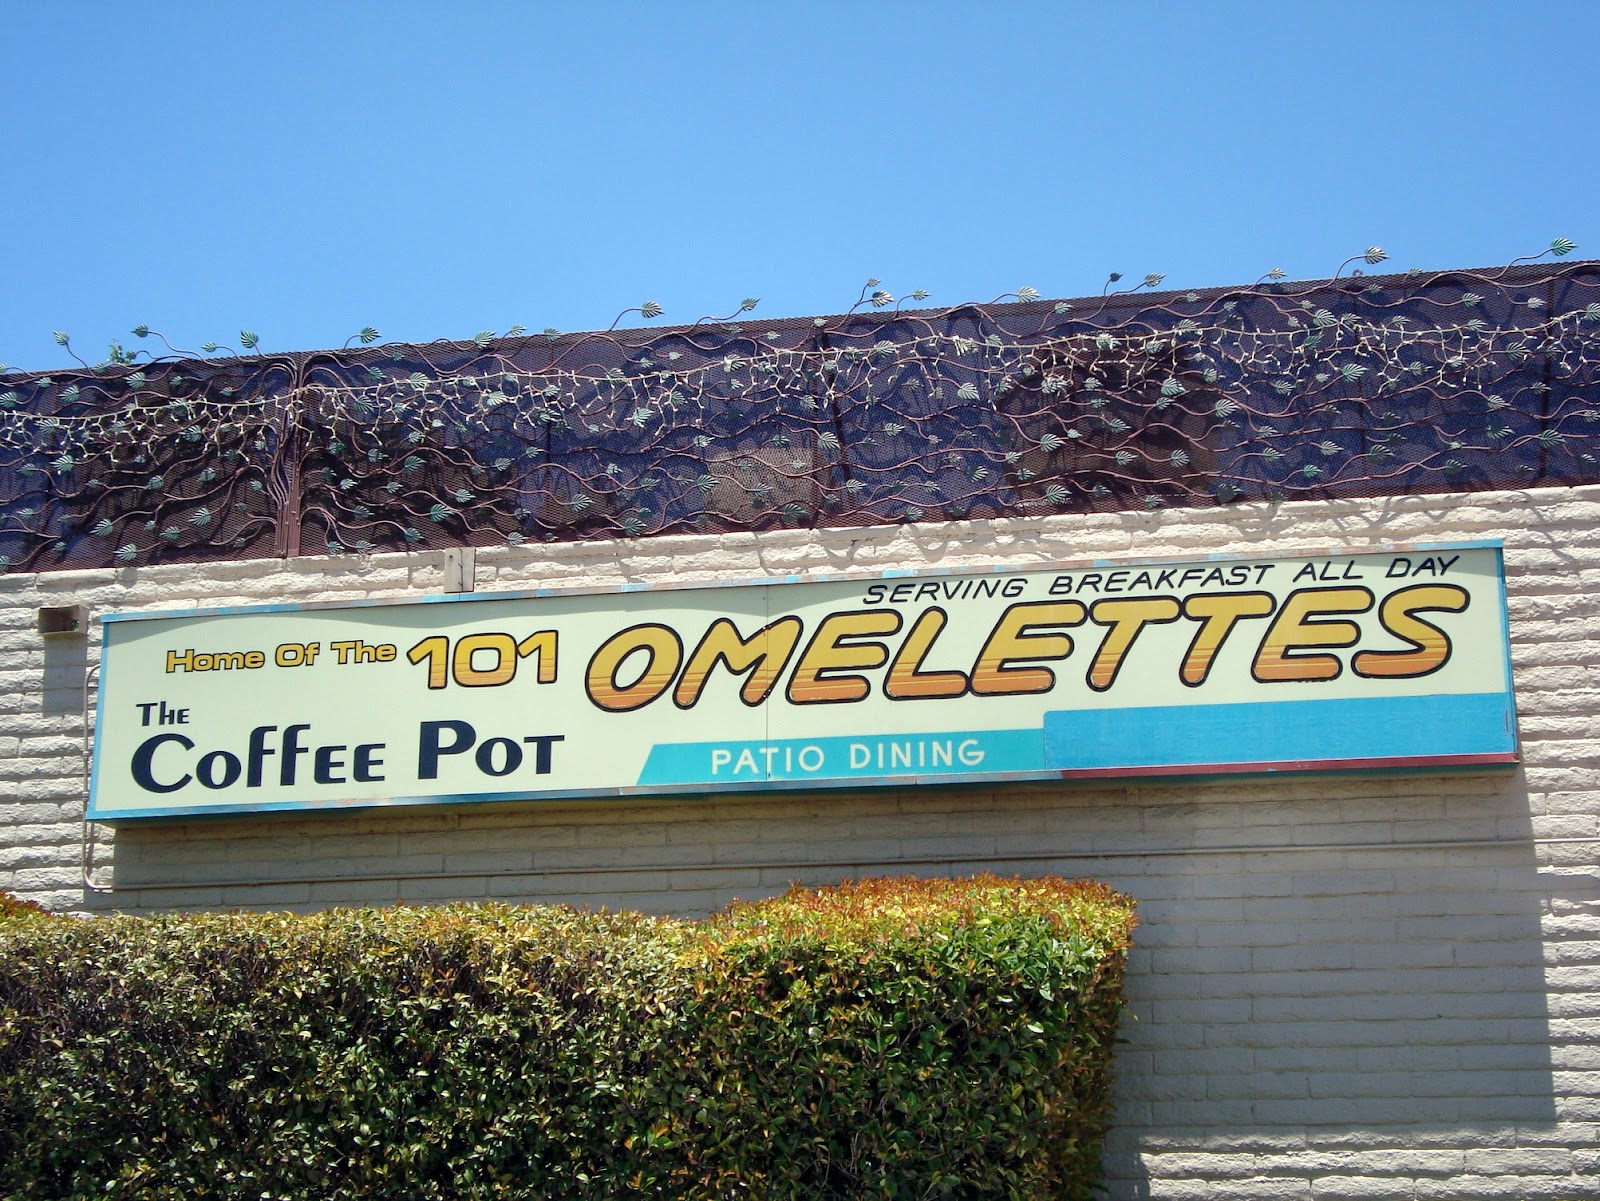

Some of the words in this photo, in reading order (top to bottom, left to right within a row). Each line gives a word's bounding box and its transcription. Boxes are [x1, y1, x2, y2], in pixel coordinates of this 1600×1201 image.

[863, 578, 1028, 605] SERVING
[1049, 564, 1275, 595] BREAKFAST
[1293, 561, 1364, 583] ALL
[1386, 555, 1460, 578] DAY
[165, 649, 264, 674] Home
[275, 642, 321, 668] Of
[330, 640, 397, 665] The
[407, 629, 559, 690] 101
[585, 583, 1471, 713] OMELETTES
[711, 745, 825, 775] PATIO
[850, 739, 986, 770] DINING
